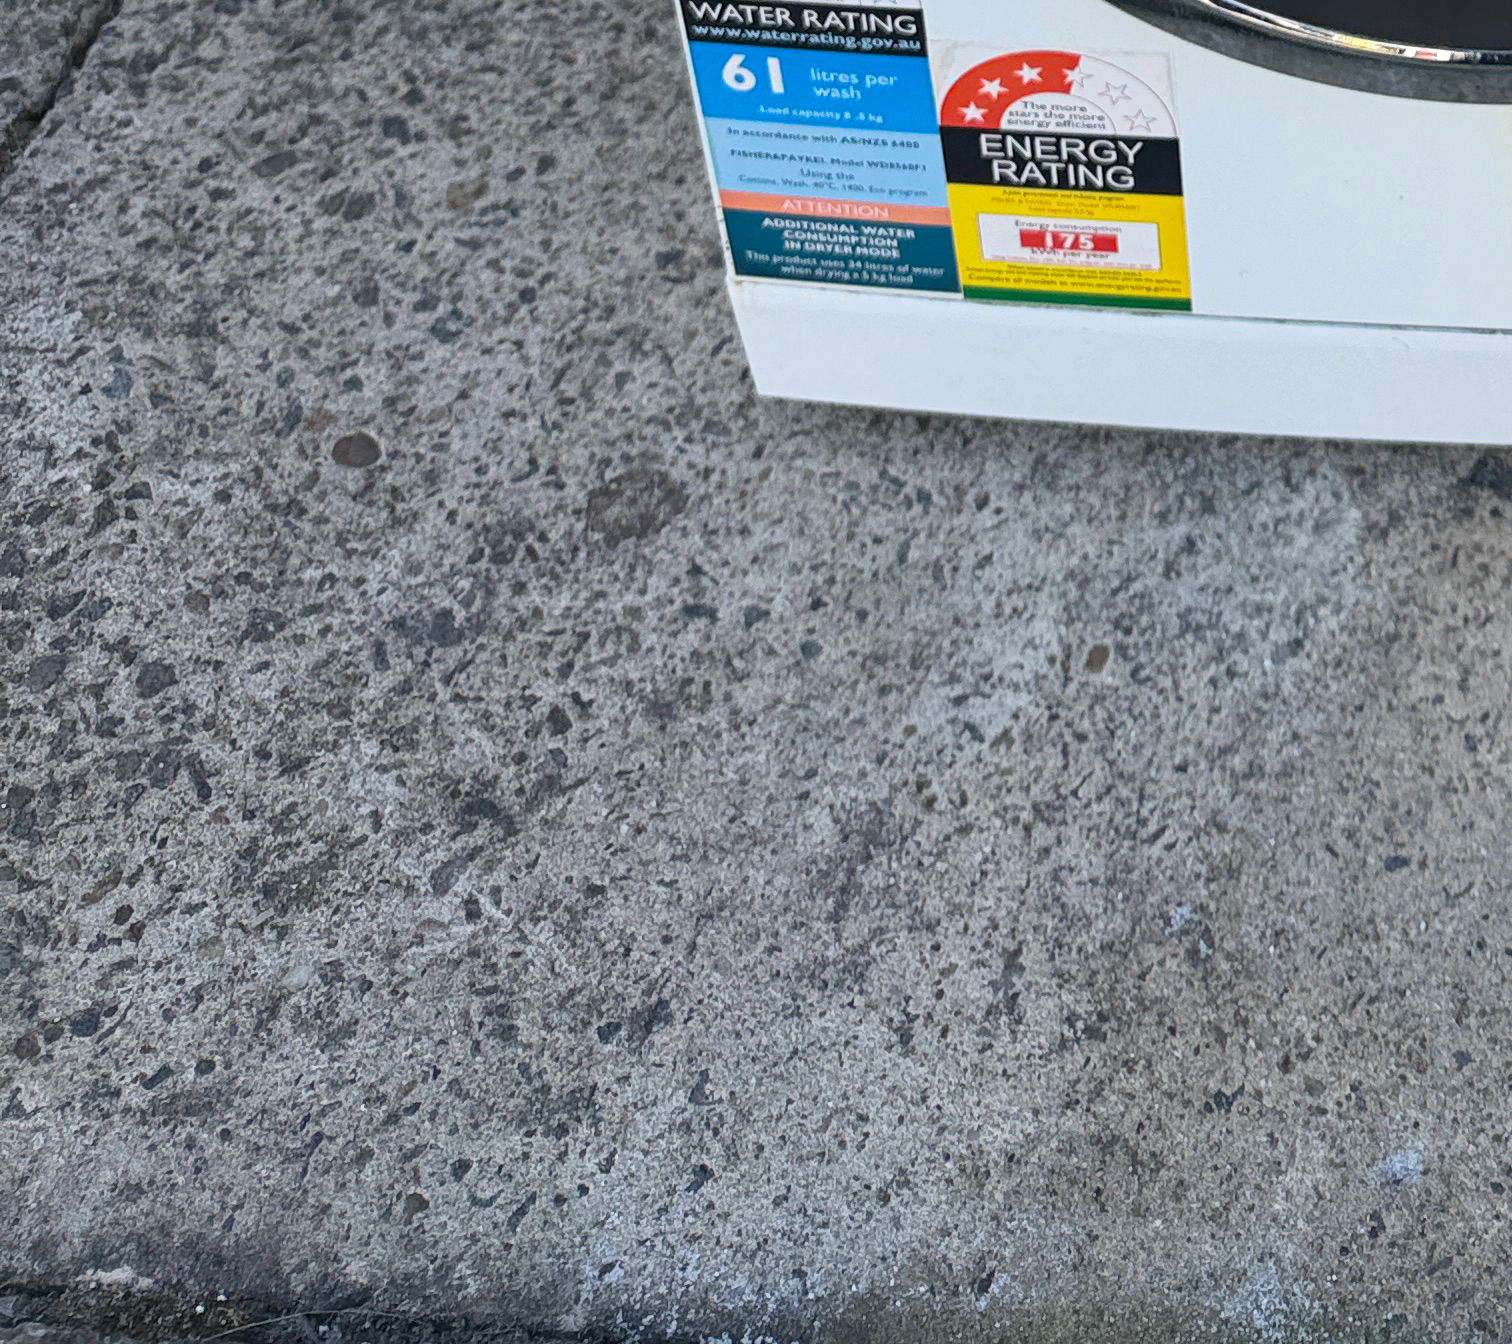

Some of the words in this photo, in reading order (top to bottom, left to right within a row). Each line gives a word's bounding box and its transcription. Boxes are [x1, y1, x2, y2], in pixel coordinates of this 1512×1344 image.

[689, 0, 795, 27] WATER
[802, 9, 918, 35] RATING
[692, 25, 921, 51] www.waterrating.gov.au
[722, 53, 784, 94] 61
[810, 68, 859, 84] litres
[865, 74, 898, 88] per
[814, 86, 861, 100] wash
[1020, 100, 1048, 111] The
[1007, 118, 1052, 129] energy
[1055, 120, 1106, 130] efficient
[1009, 111, 1040, 119] stars
[1044, 111, 1065, 120] the
[1069, 113, 1105, 121] more
[979, 133, 1144, 166] ENERGY
[991, 159, 1136, 191] RATING
[782, 200, 889, 218] ATTENTION
[762, 217, 858, 234] ADDITIONAL
[862, 225, 915, 239] WATER
[783, 230, 898, 248] CONSUMPTION
[784, 240, 801, 250] IN
[804, 242, 852, 255] DRYER
[856, 247, 900, 258] MODE
[1044, 231, 1095, 251] 175
